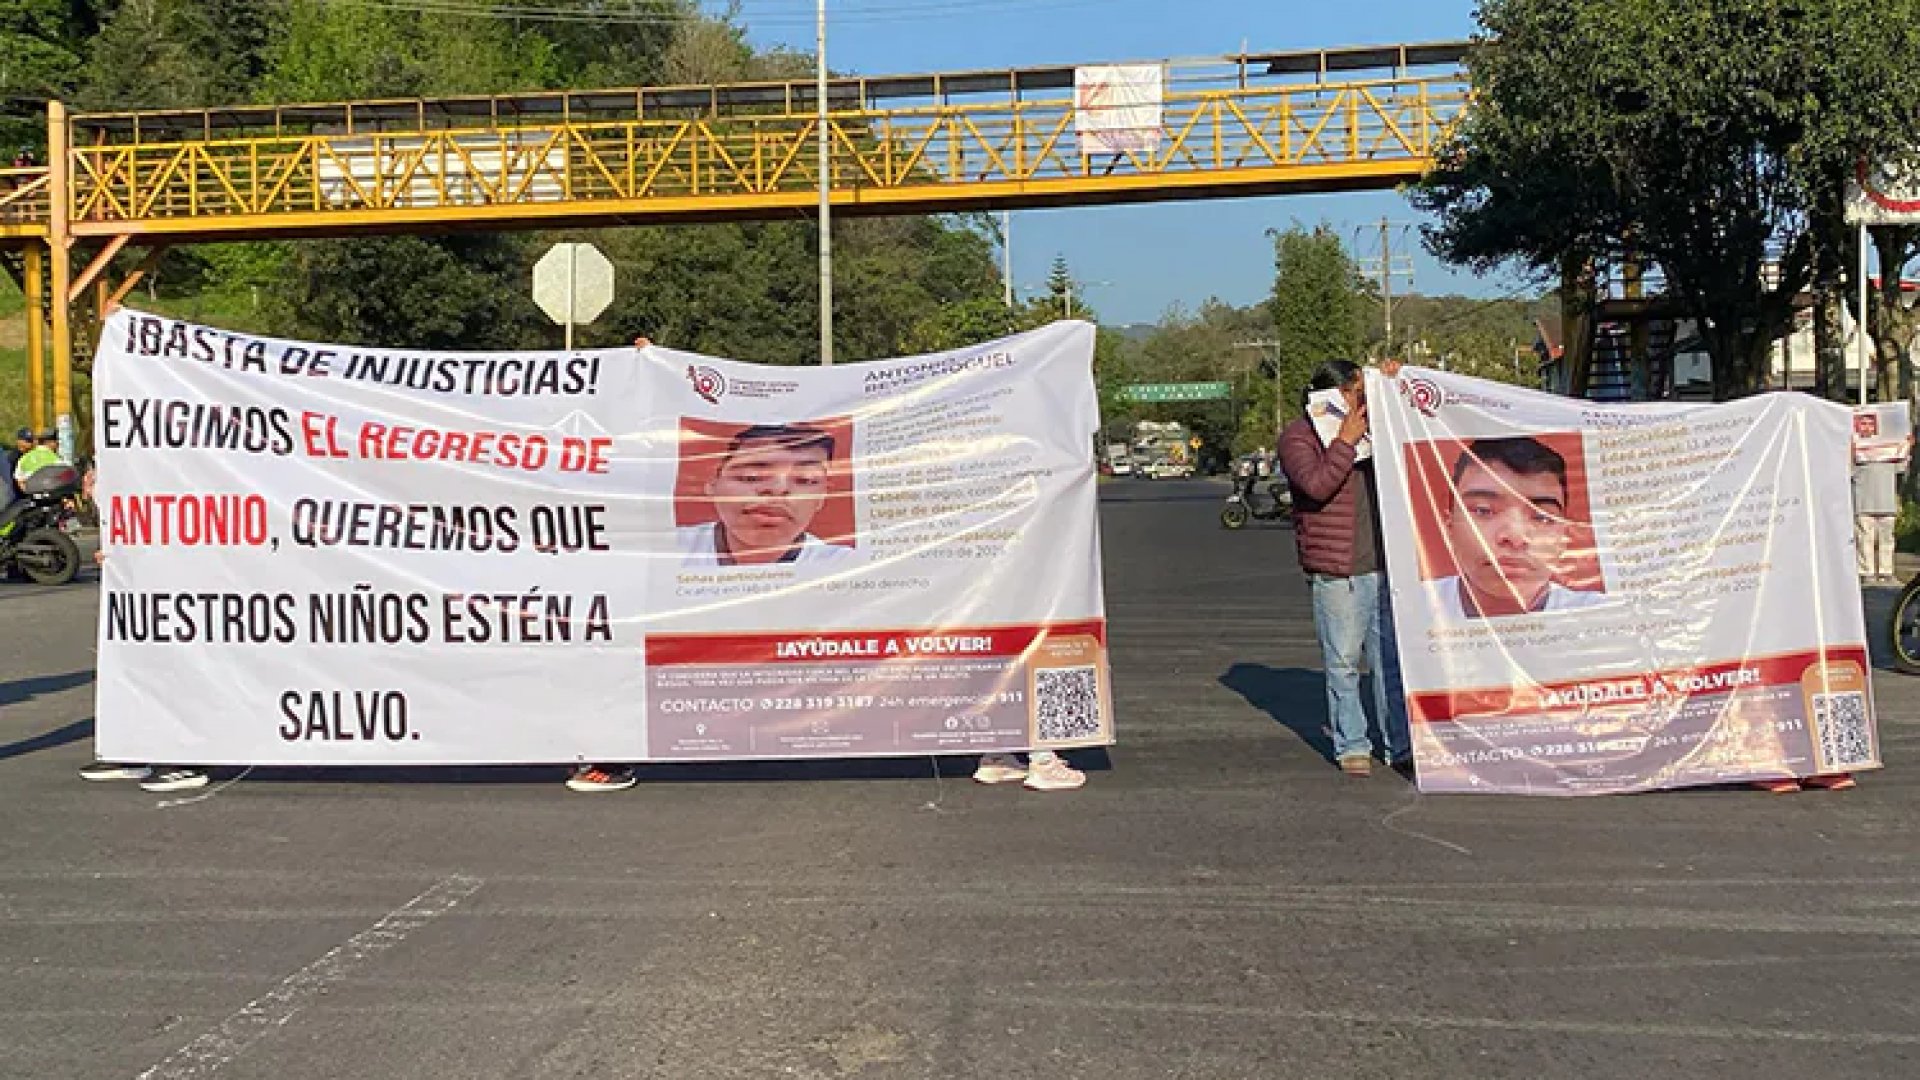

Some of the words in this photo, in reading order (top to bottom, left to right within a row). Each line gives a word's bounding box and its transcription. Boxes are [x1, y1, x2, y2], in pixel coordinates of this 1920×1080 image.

[125, 316, 267, 374] ¡BASTA
[279, 345, 338, 377] DE
[344, 352, 600, 395] INJUSTICIAS!
[103, 399, 294, 455] EXIGIMOS
[301, 411, 349, 459] EL
[359, 421, 548, 471] REGRESO
[560, 438, 613, 475] DE
[109, 495, 280, 552] ANTONIO,
[292, 499, 520, 552] QUEREMOS
[532, 504, 611, 555] QUE
[911, 504, 927, 515] de
[107, 593, 296, 643] NUESTROS
[310, 584, 429, 644] NIÑOS
[443, 586, 572, 644] ESTÉN
[584, 594, 613, 643] A
[776, 637, 879, 658] ¡AYÚDALE
[885, 638, 899, 655] A
[905, 635, 992, 654] VOLVER!
[660, 697, 753, 714] CONTACTO
[1000, 690, 1023, 703] 911
[1653, 678, 1669, 695] A
[1676, 667, 1761, 693] VOLVER!
[279, 690, 421, 741] SALVO.
